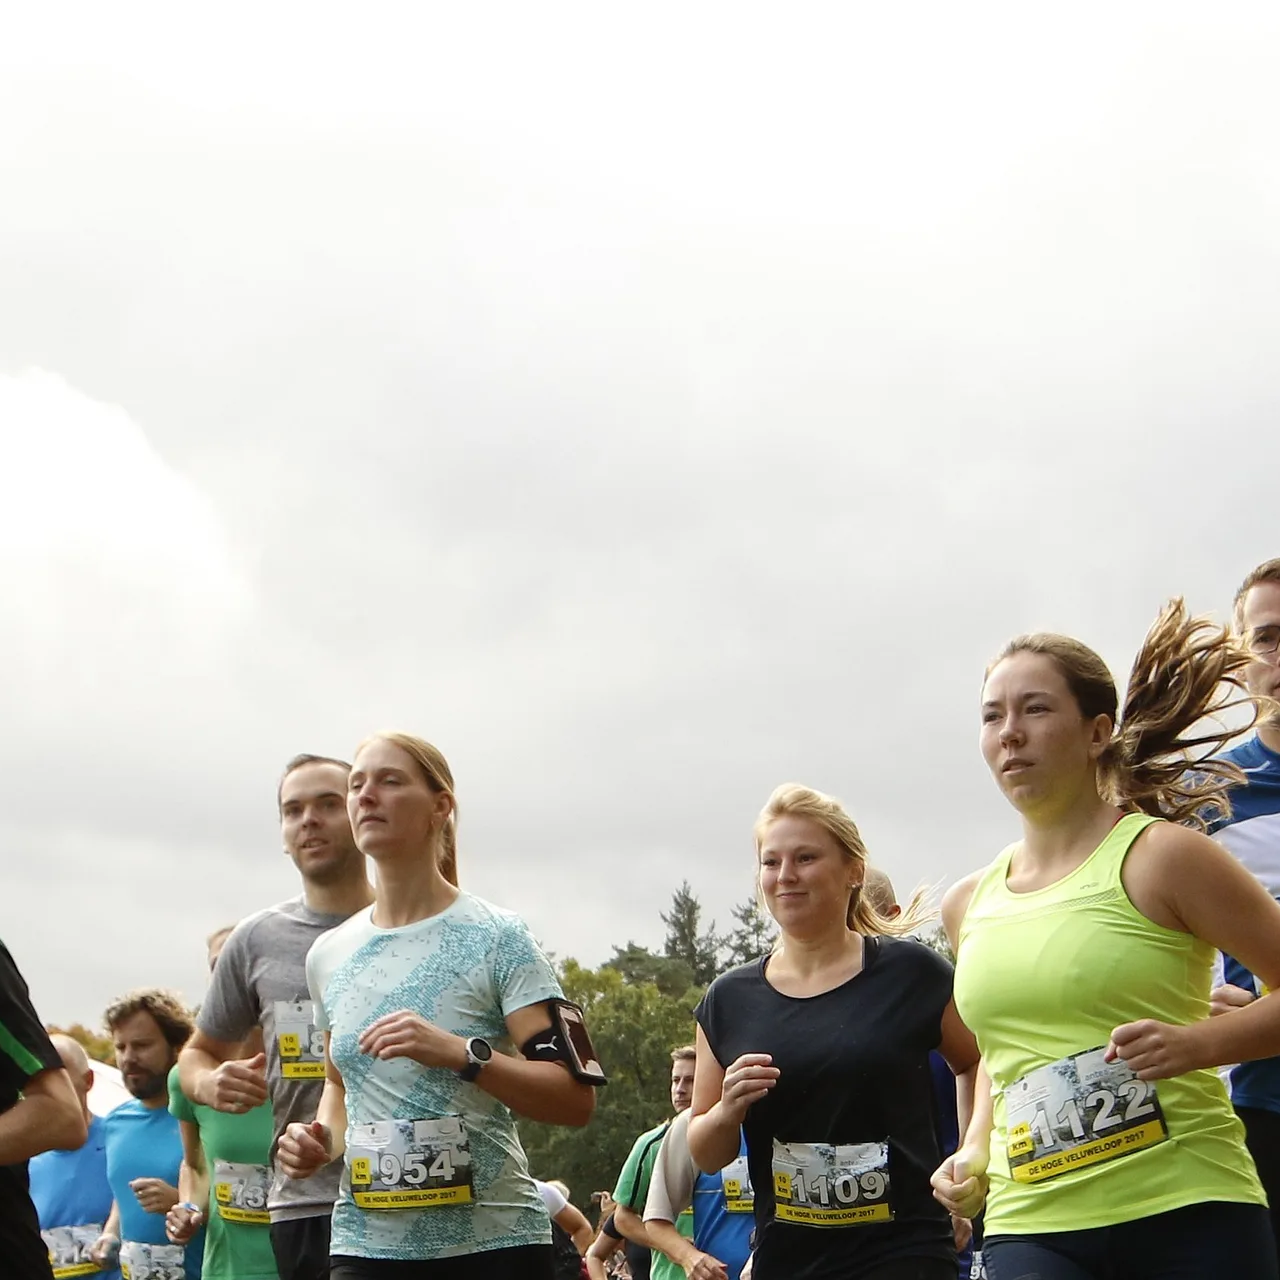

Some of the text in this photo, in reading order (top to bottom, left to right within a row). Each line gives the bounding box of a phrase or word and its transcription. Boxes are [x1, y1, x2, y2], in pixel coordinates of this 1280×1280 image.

[1030, 1079, 1156, 1149] 1122
[1012, 1140, 1027, 1151] km
[1028, 1130, 1145, 1176] DE HOGE VELUWELOOP 2017
[356, 1161, 366, 1169] 10
[380, 1150, 456, 1186] 954
[778, 1186, 789, 1194] km
[791, 1171, 886, 1205] 1109
[372, 1194, 389, 1203] HOGE
[390, 1191, 439, 1203] VELUWELOOP
[440, 1191, 457, 1200] 2017
[811, 1212, 857, 1220] VELUWELOOP
[859, 1209, 876, 1217] 2017
